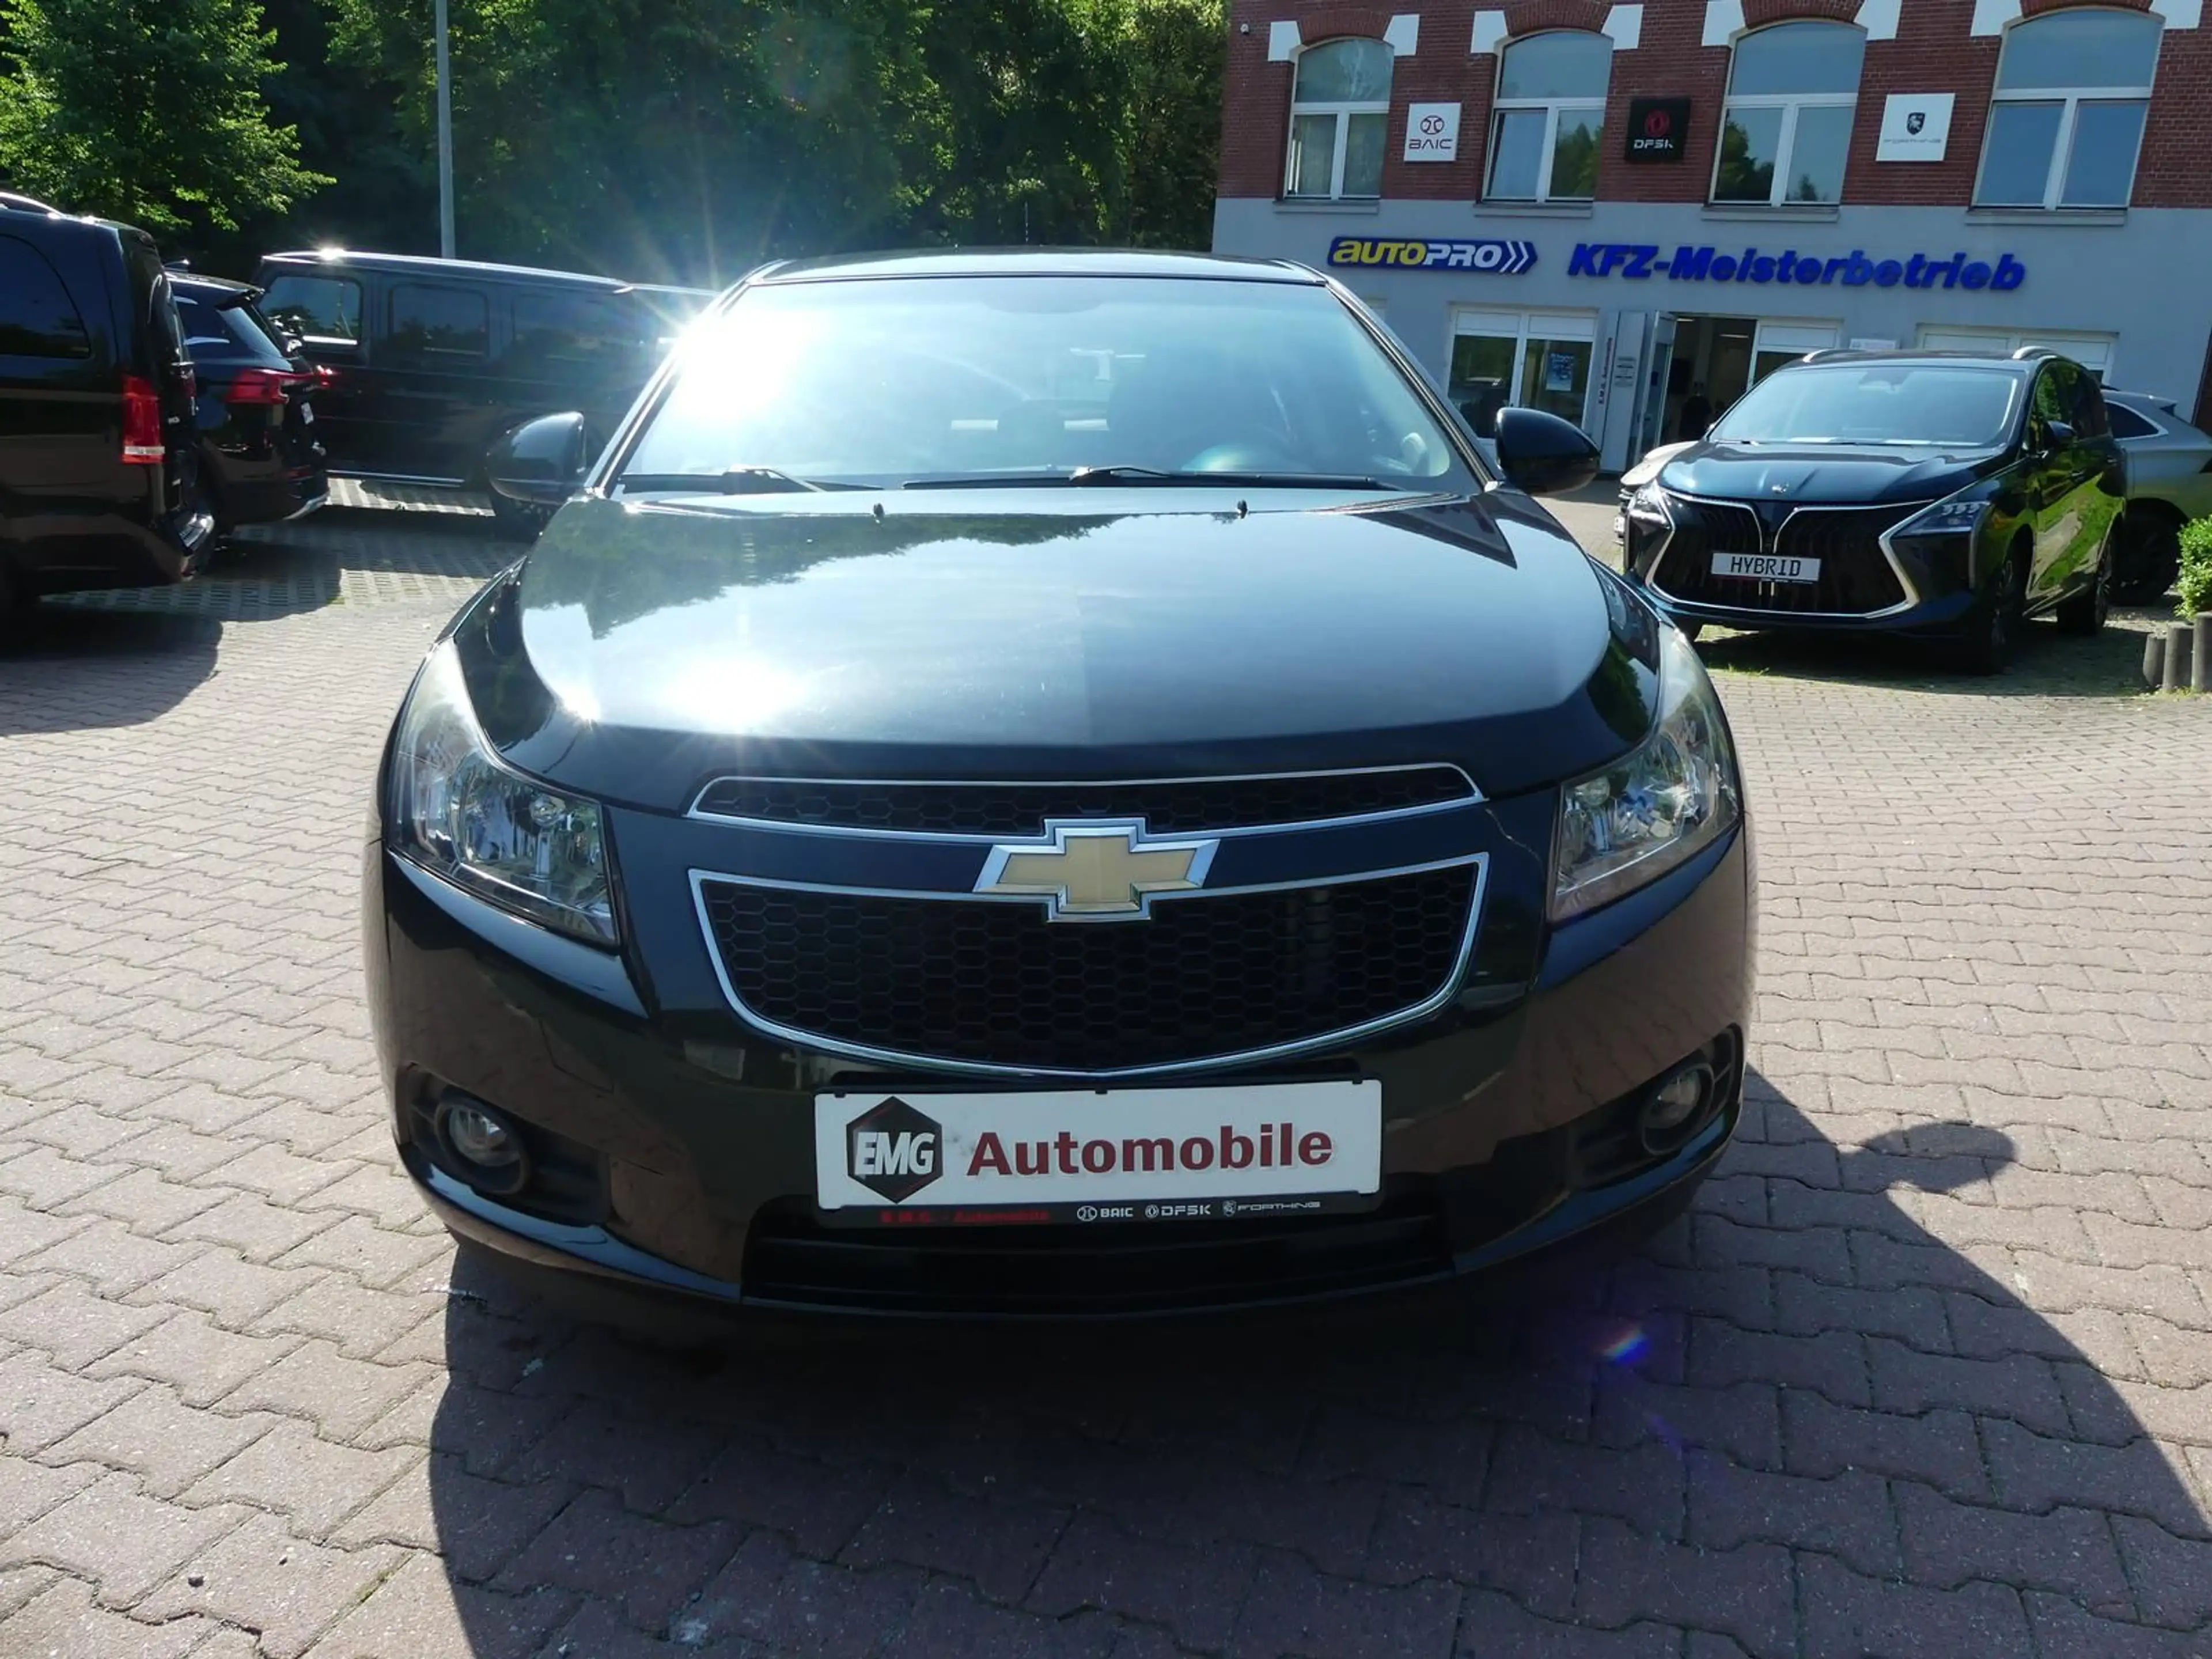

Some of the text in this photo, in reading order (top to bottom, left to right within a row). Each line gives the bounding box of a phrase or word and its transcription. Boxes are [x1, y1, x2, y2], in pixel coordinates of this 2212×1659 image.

[1634, 139, 1673, 149] DFSK
[1567, 244, 2026, 290] KFZ-Meisterbetrieb
[1730, 556, 1801, 577] HYBRID
[854, 1123, 1332, 1176] EMG Automobile
[1100, 1207, 1134, 1218] BAIC
[1161, 1205, 1211, 1217] DFSK
